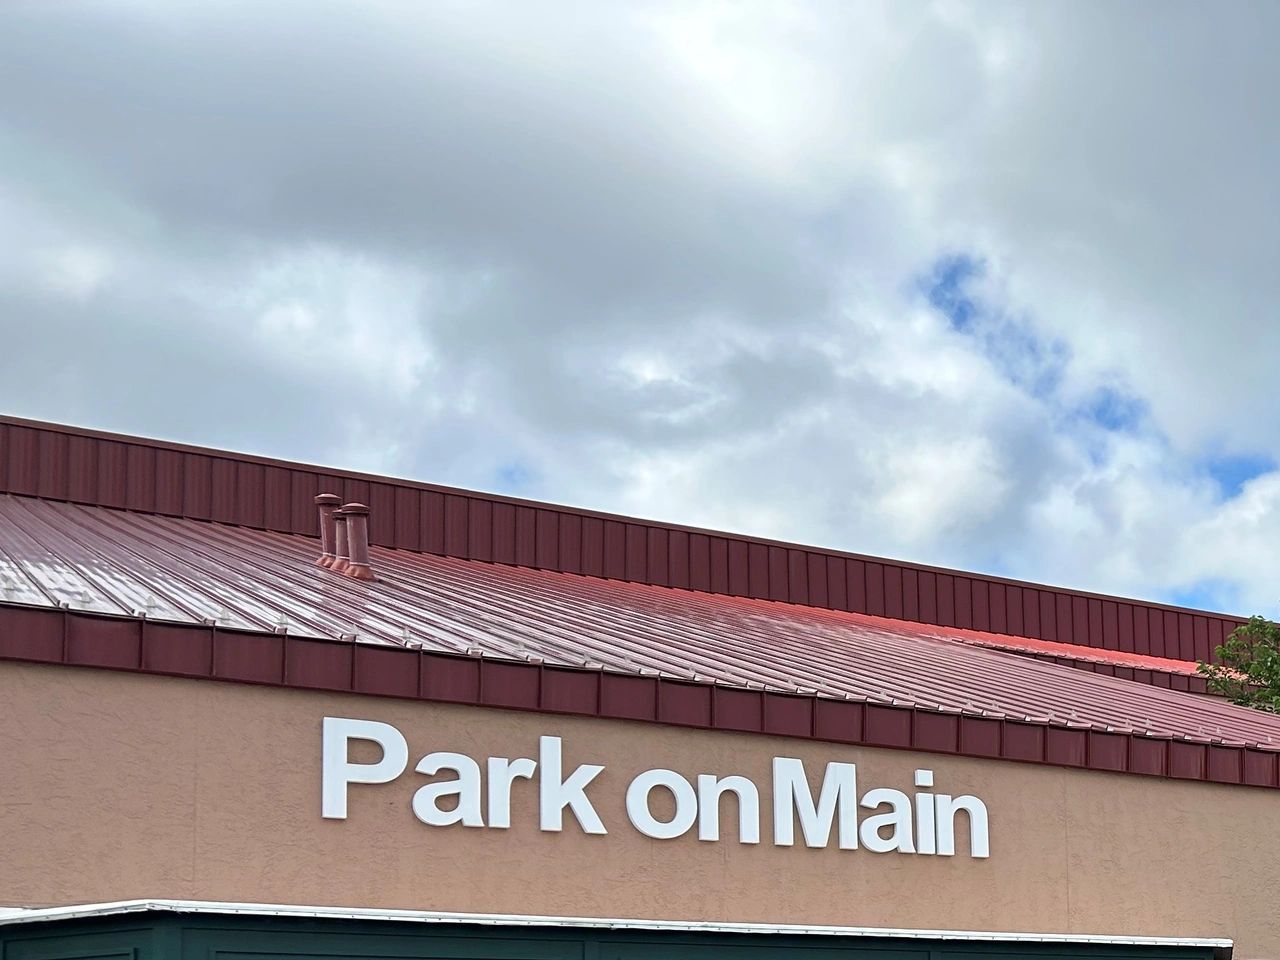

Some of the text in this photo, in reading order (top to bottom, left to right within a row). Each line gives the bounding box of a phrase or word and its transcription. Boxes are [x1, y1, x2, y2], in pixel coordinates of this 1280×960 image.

[321, 716, 990, 858] Park on Main
